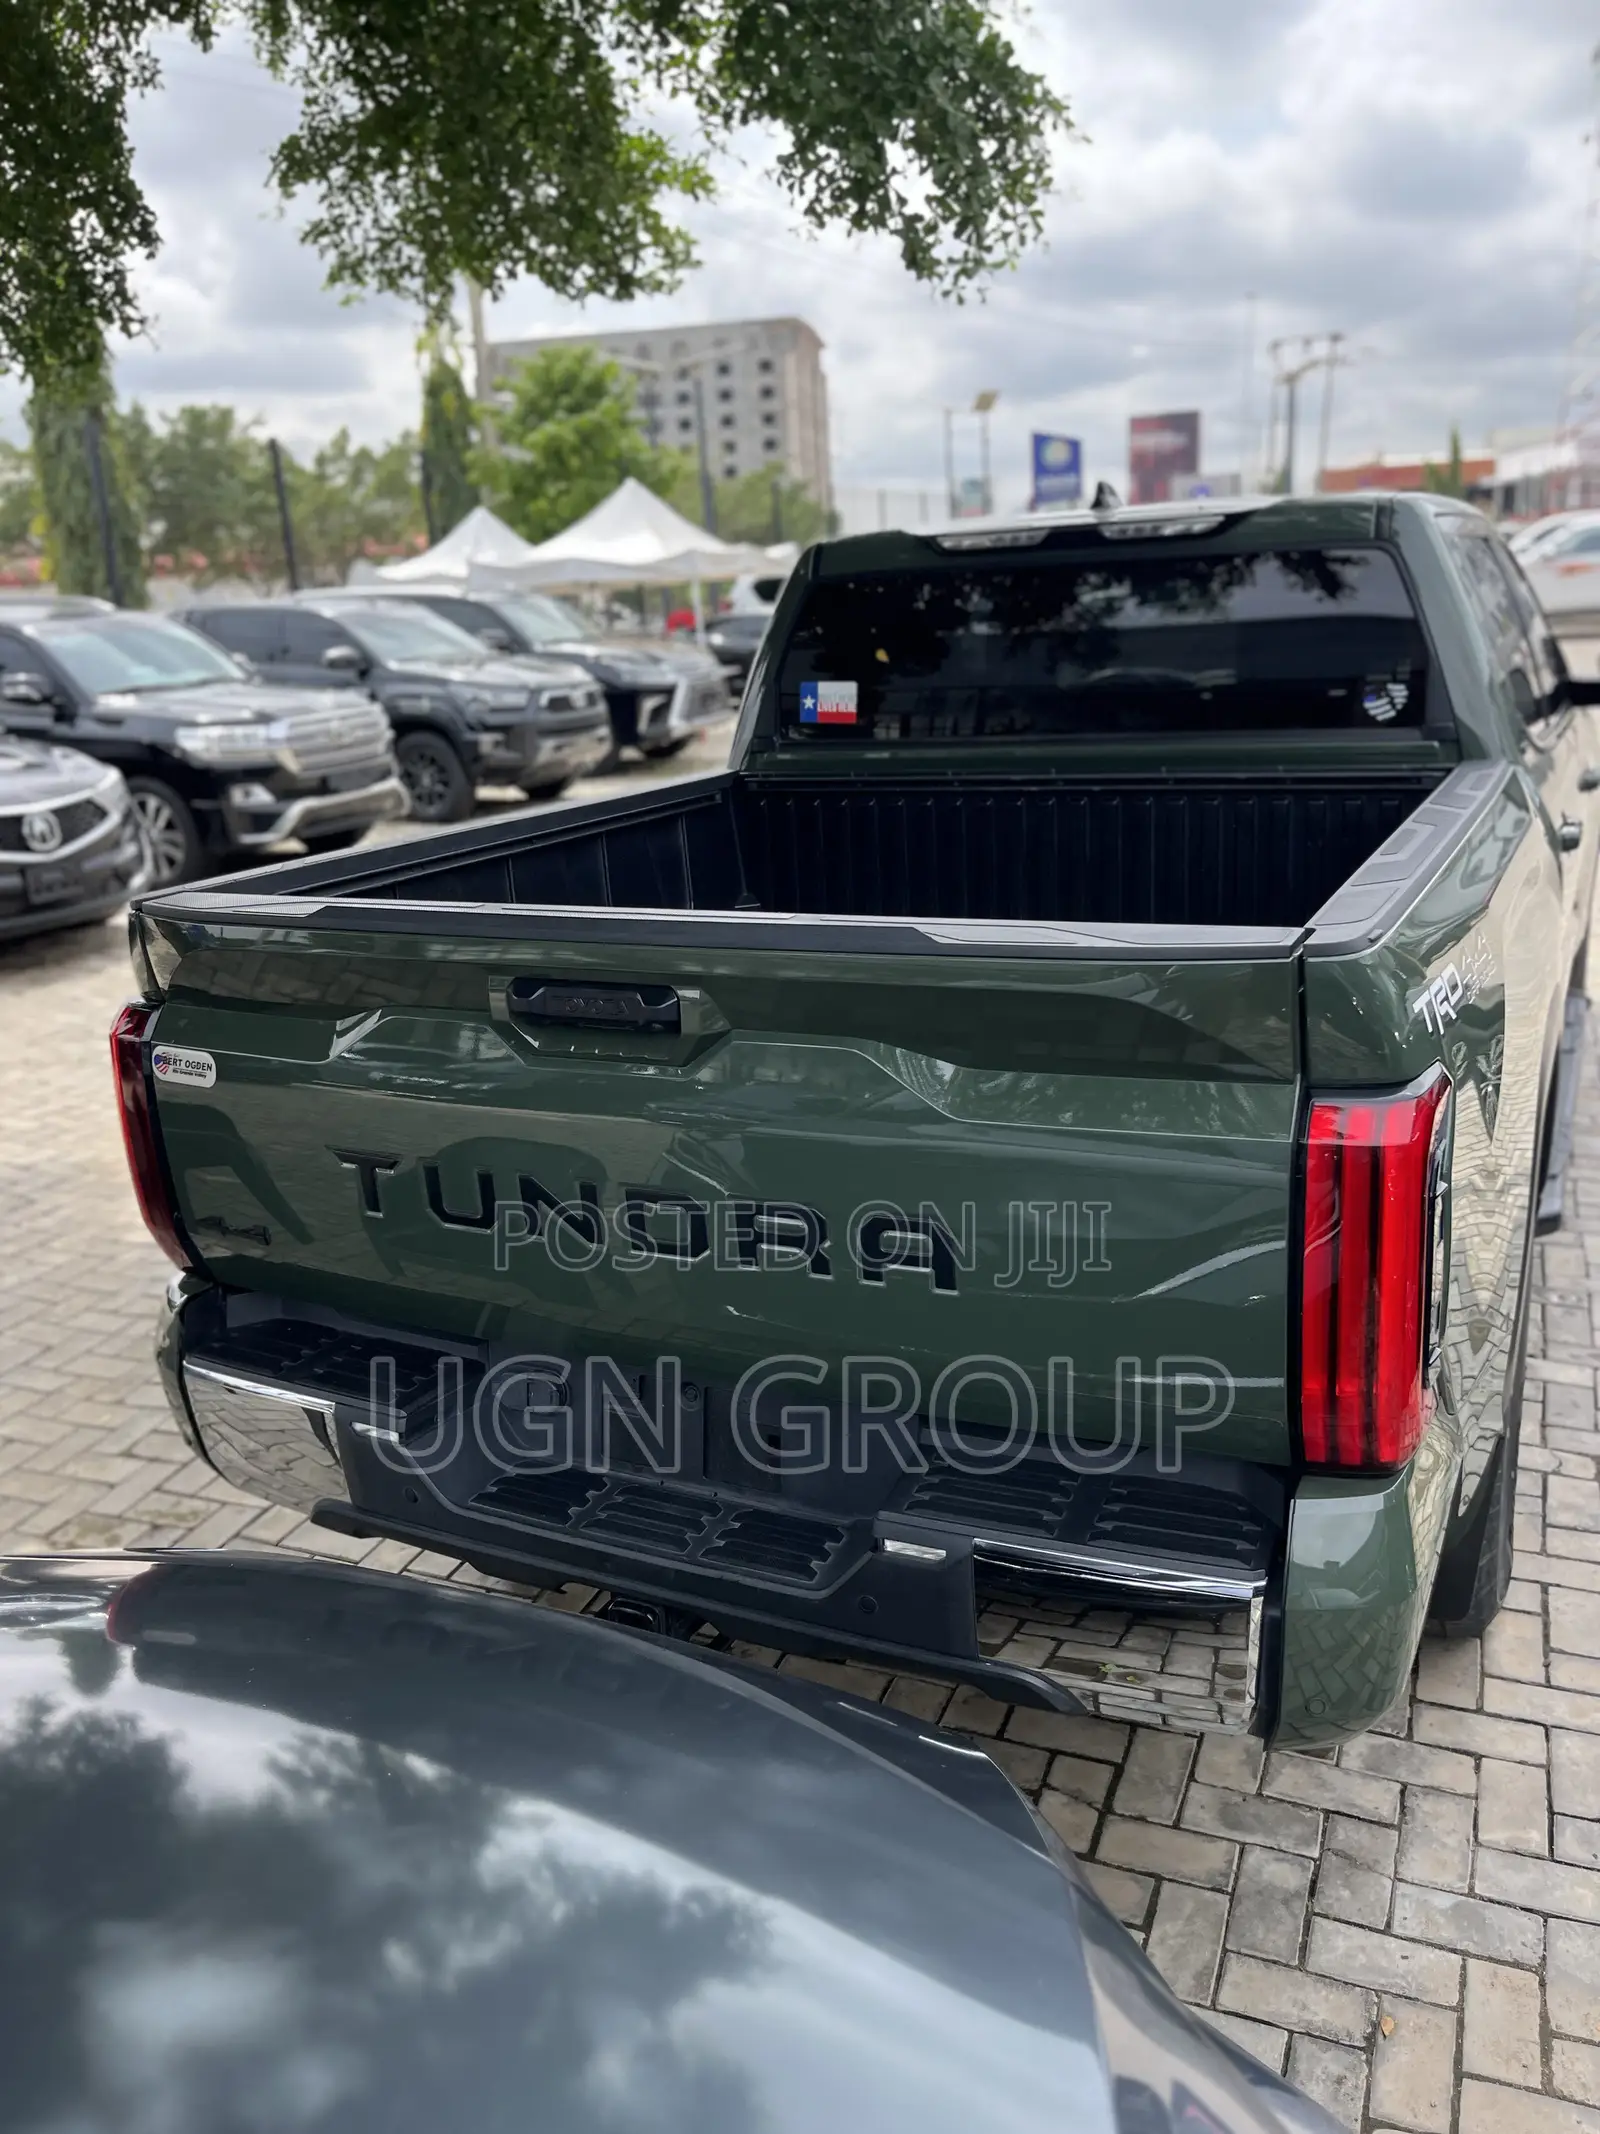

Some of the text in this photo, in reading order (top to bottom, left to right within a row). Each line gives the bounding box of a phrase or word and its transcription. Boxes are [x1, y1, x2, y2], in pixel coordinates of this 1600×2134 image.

[1412, 962, 1464, 1035] TRD
[185, 1060, 213, 1072] OGDEN
[334, 1151, 960, 1295] TUNDRA
